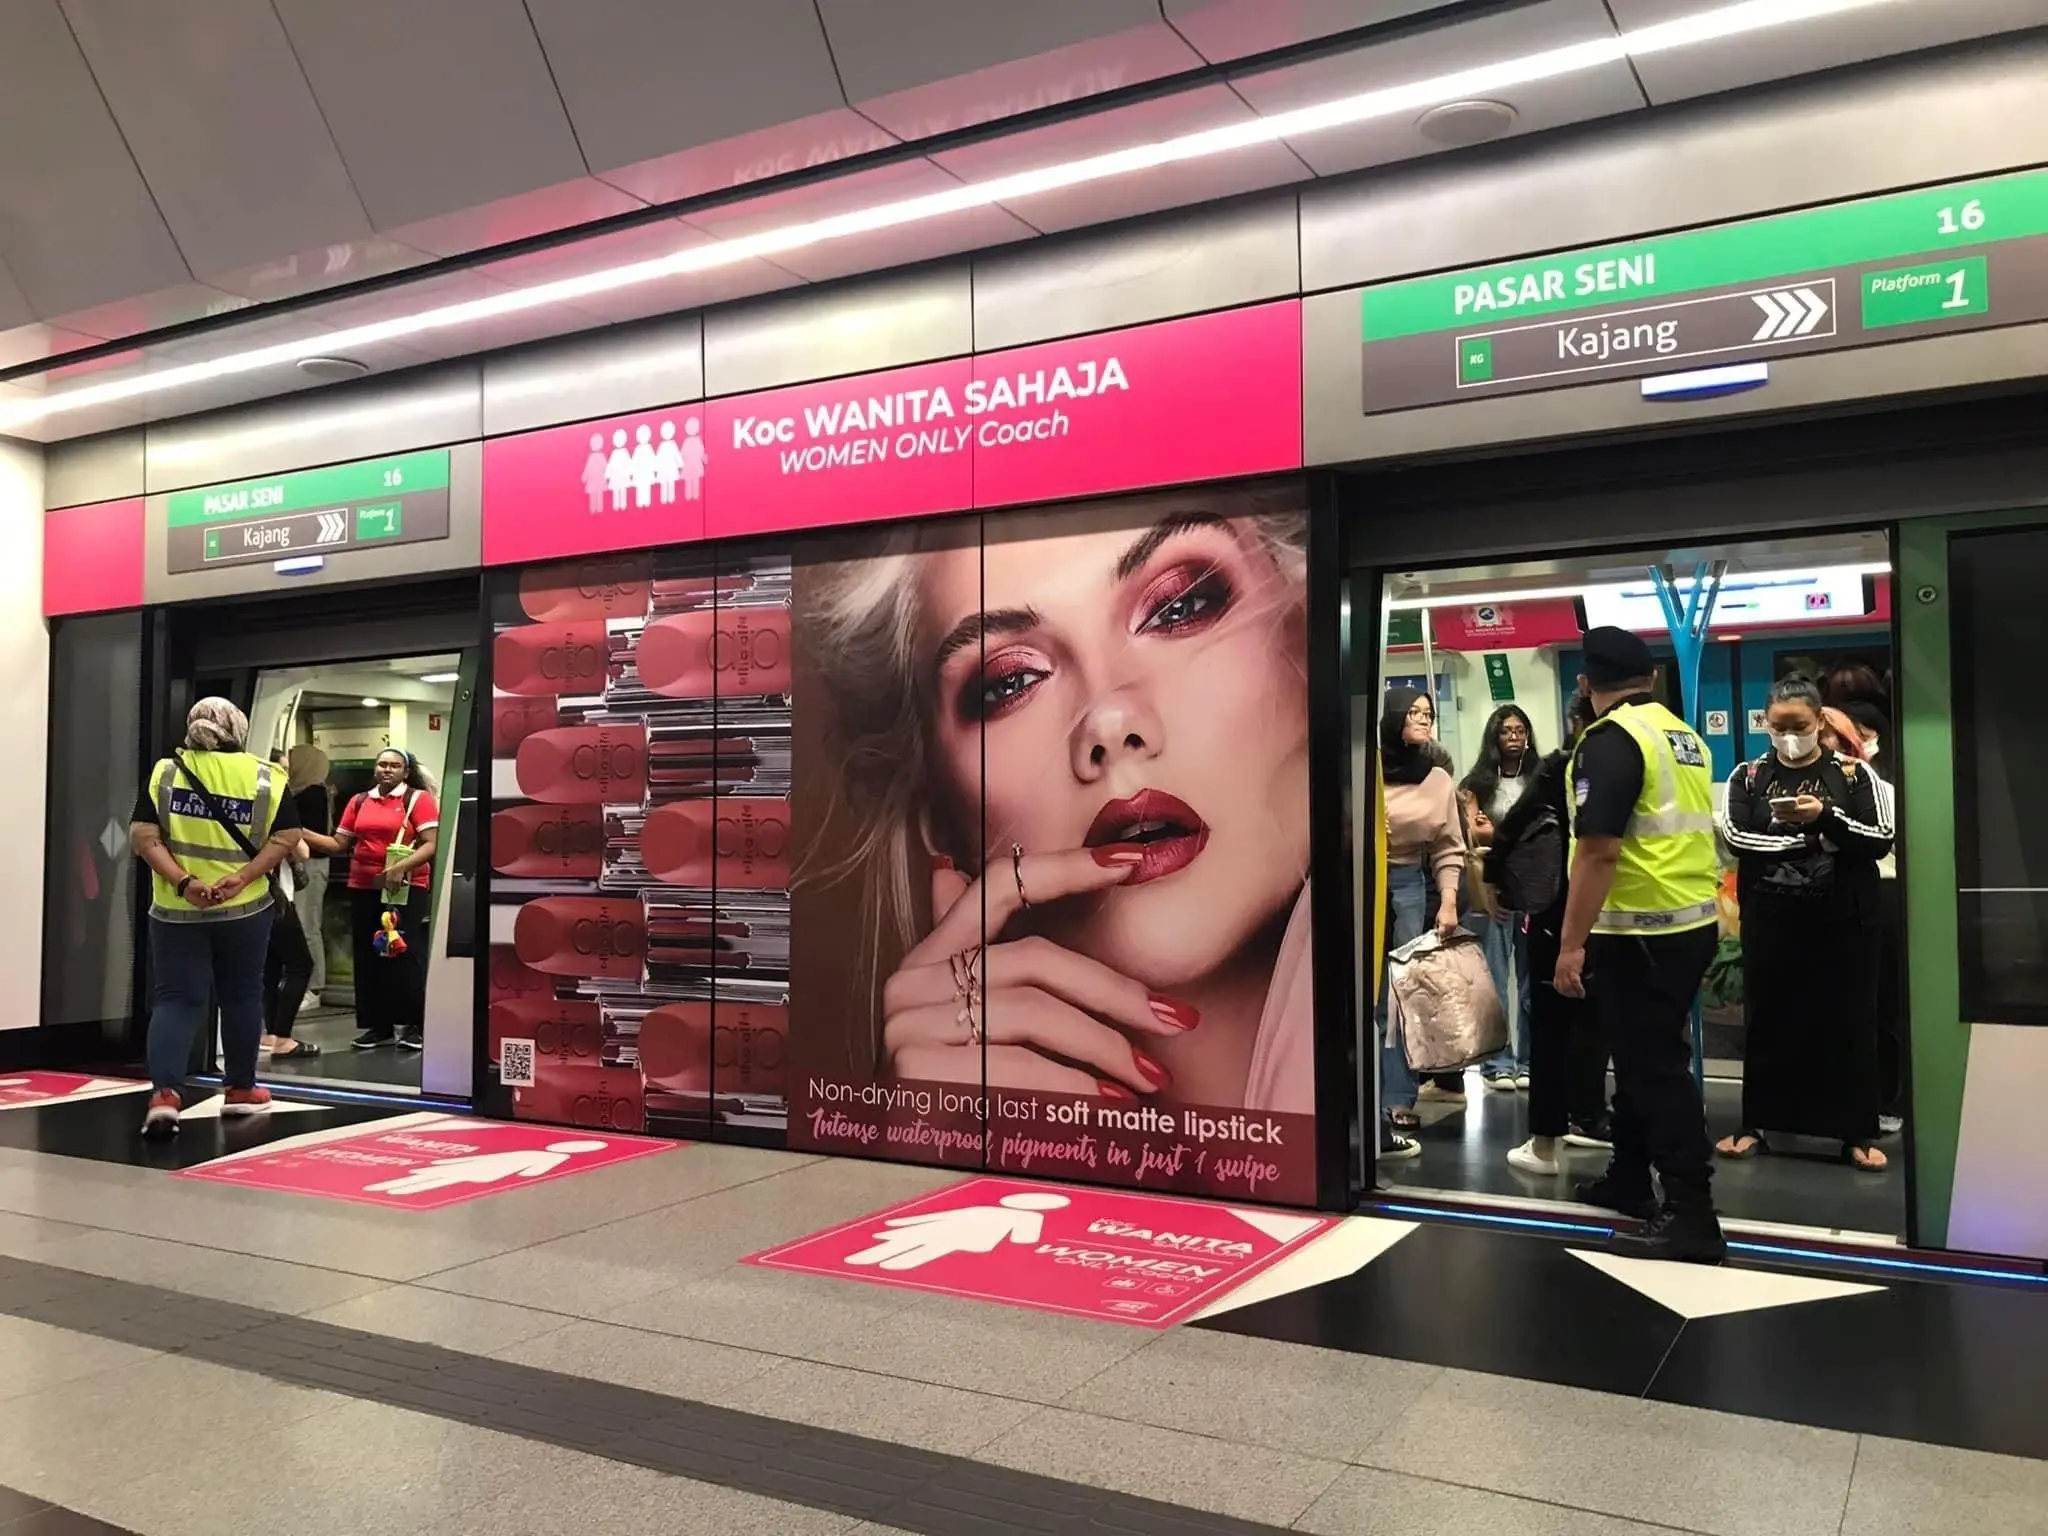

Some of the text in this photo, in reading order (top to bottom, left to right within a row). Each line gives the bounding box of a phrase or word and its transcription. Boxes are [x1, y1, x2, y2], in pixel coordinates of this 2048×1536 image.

[1936, 200, 1986, 235] 16
[1453, 252, 1657, 315] PASAR SENI
[1871, 272, 1942, 297] Platform
[1941, 269, 1969, 309] 1
[1556, 317, 1679, 359] Kajang
[1469, 354, 1485, 366] KG
[732, 356, 1130, 450] Koc WANITA SAHAJA
[779, 410, 1071, 476] WOMEN ONLY Coach
[383, 468, 403, 487] 16
[204, 485, 284, 515] PASAR SENI
[243, 526, 290, 548] Kajang
[384, 509, 395, 532] 1
[171, 800, 252, 823] BANAN
[188, 792, 241, 810] PIS
[808, 1077, 1285, 1146] Non-drying long last soft matte lipstick
[805, 1107, 880, 1145] Intense
[886, 1118, 994, 1165] waterproof
[1000, 1130, 1098, 1170] pigments
[1106, 1140, 1132, 1167] in
[1135, 1144, 1193, 1182] just
[1213, 1152, 1282, 1194] swipe
[1087, 1220, 1254, 1255] WANITA
[1034, 1244, 1222, 1277] WOMEN
